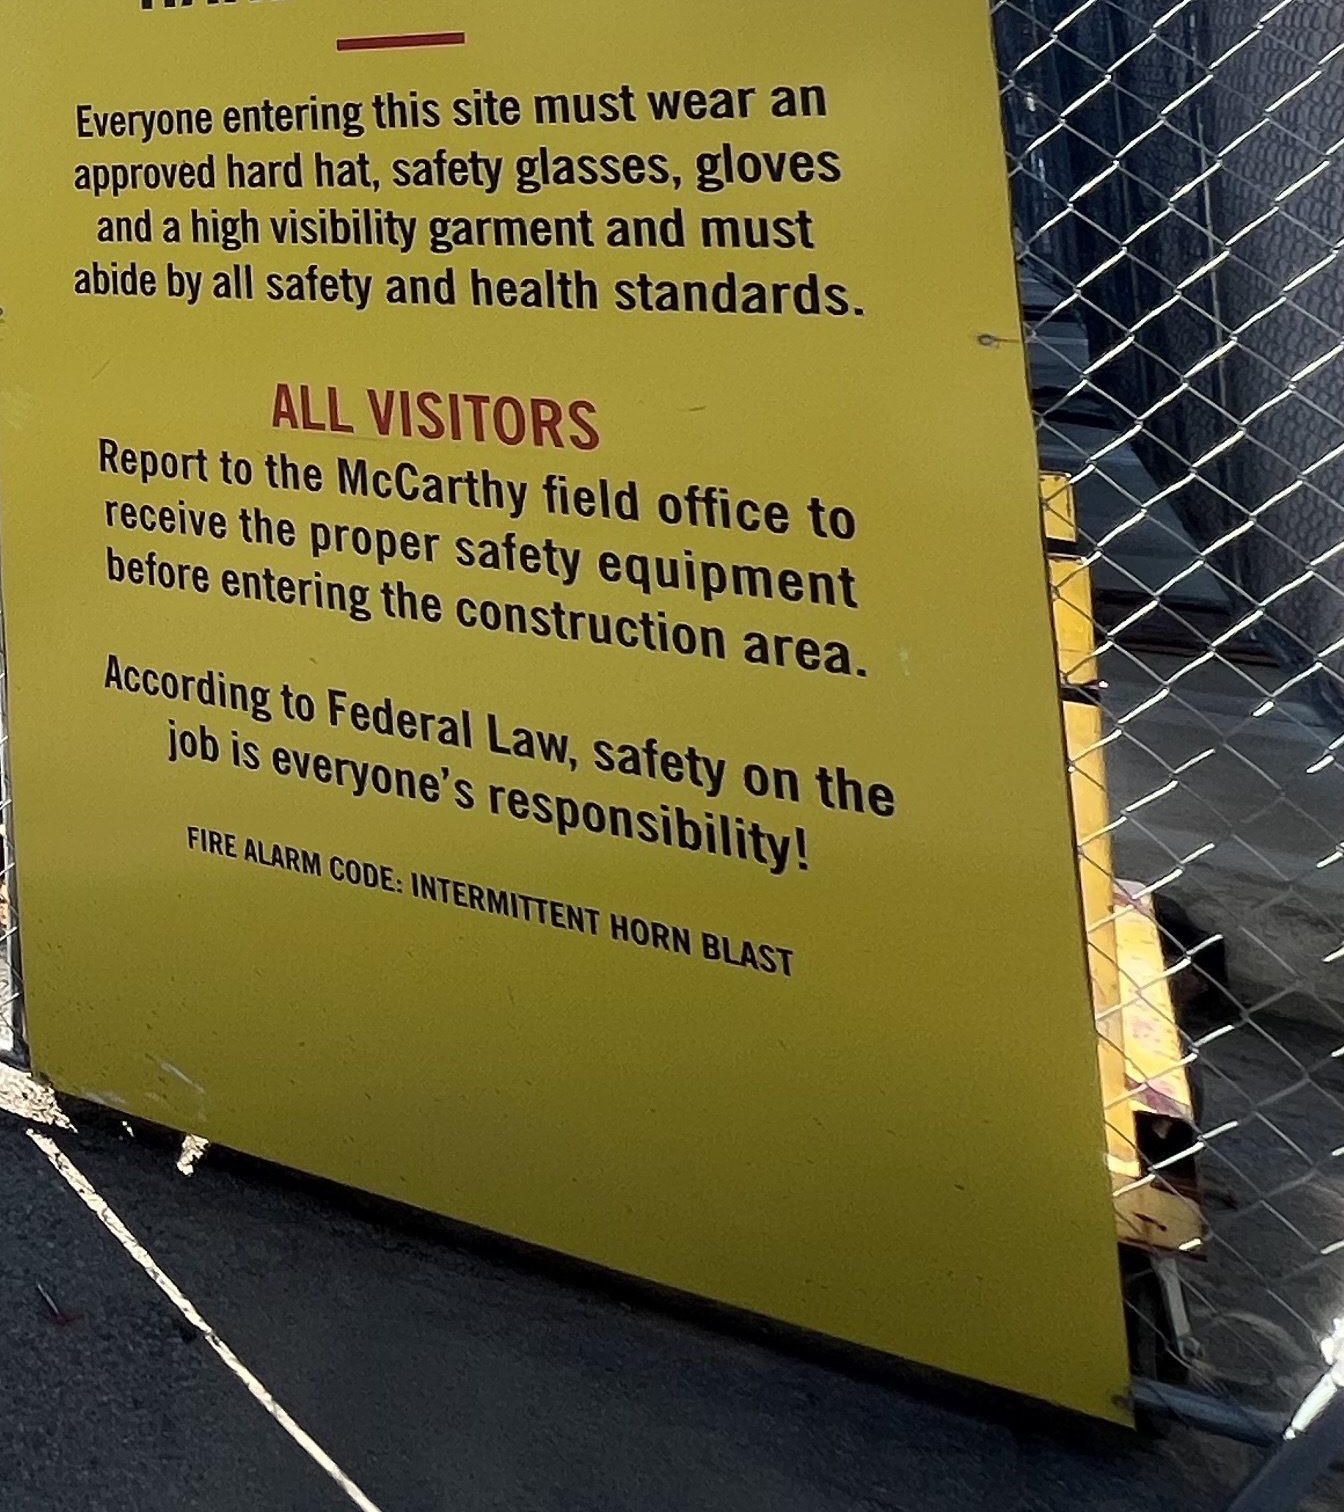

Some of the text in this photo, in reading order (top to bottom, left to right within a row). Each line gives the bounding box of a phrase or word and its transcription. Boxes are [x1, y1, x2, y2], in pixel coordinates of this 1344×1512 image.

[75, 84, 827, 143] Everyone entering this site must wear an
[74, 142, 841, 197] approved hard hat, safety glasses, gloves
[96, 207, 815, 254] and a high visibility garment and must
[74, 261, 865, 316] abide by all safety and health standards.
[272, 382, 600, 451] ALL VISITORS
[98, 437, 855, 540] Report to the McCarthy field office to
[105, 500, 858, 608] receive the proper safety equipment
[106, 546, 867, 677] before entering the construction area.
[105, 654, 895, 817] According to Federal Law, safety on the
[168, 719, 219, 762] job
[231, 730, 260, 770] is
[489, 783, 808, 875] responsibility!
[187, 826, 794, 977] FIRE ALARM CODE: INTERMITTENT HORN BLAST
